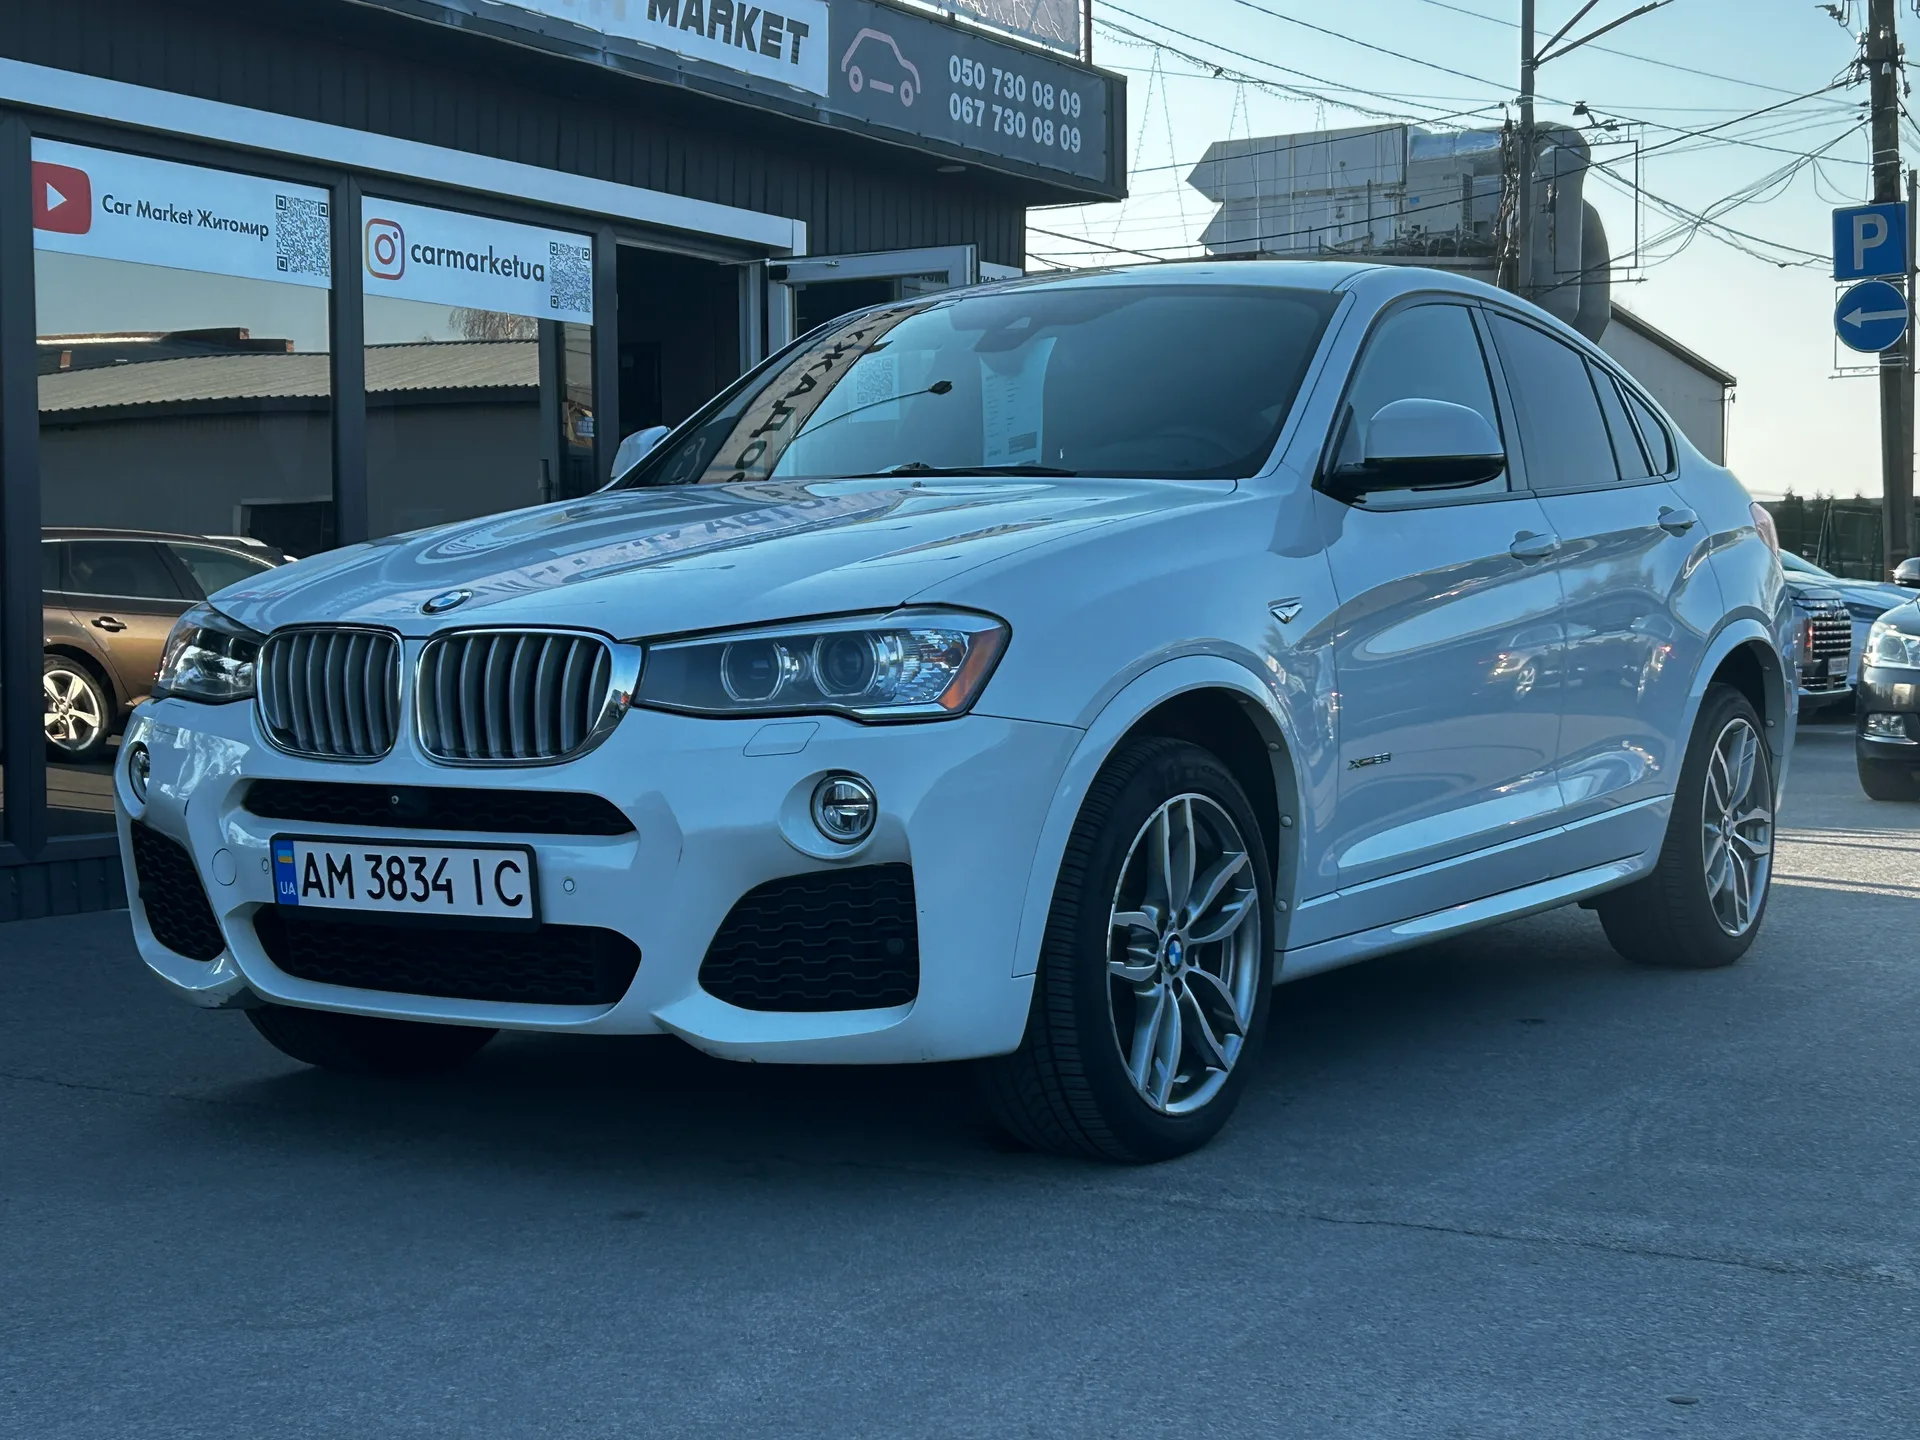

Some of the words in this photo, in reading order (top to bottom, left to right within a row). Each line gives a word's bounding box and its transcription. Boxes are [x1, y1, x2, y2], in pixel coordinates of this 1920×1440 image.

[948, 54, 986, 91] 050
[992, 67, 1026, 102] 730
[1032, 80, 1054, 111] 08
[1060, 88, 1081, 118] 09
[949, 92, 985, 127] 067
[992, 104, 1026, 138] 730
[1032, 116, 1054, 146] 08
[1060, 124, 1081, 153] 09
[101, 194, 132, 216] Car
[136, 199, 193, 225] Market
[197, 208, 269, 242] Житомир
[1853, 214, 1888, 270] P
[410, 243, 545, 282] carmarketua
[280, 881, 297, 896] UA
[302, 852, 355, 899] AM
[363, 853, 454, 904] 3834
[472, 858, 523, 907] IC
